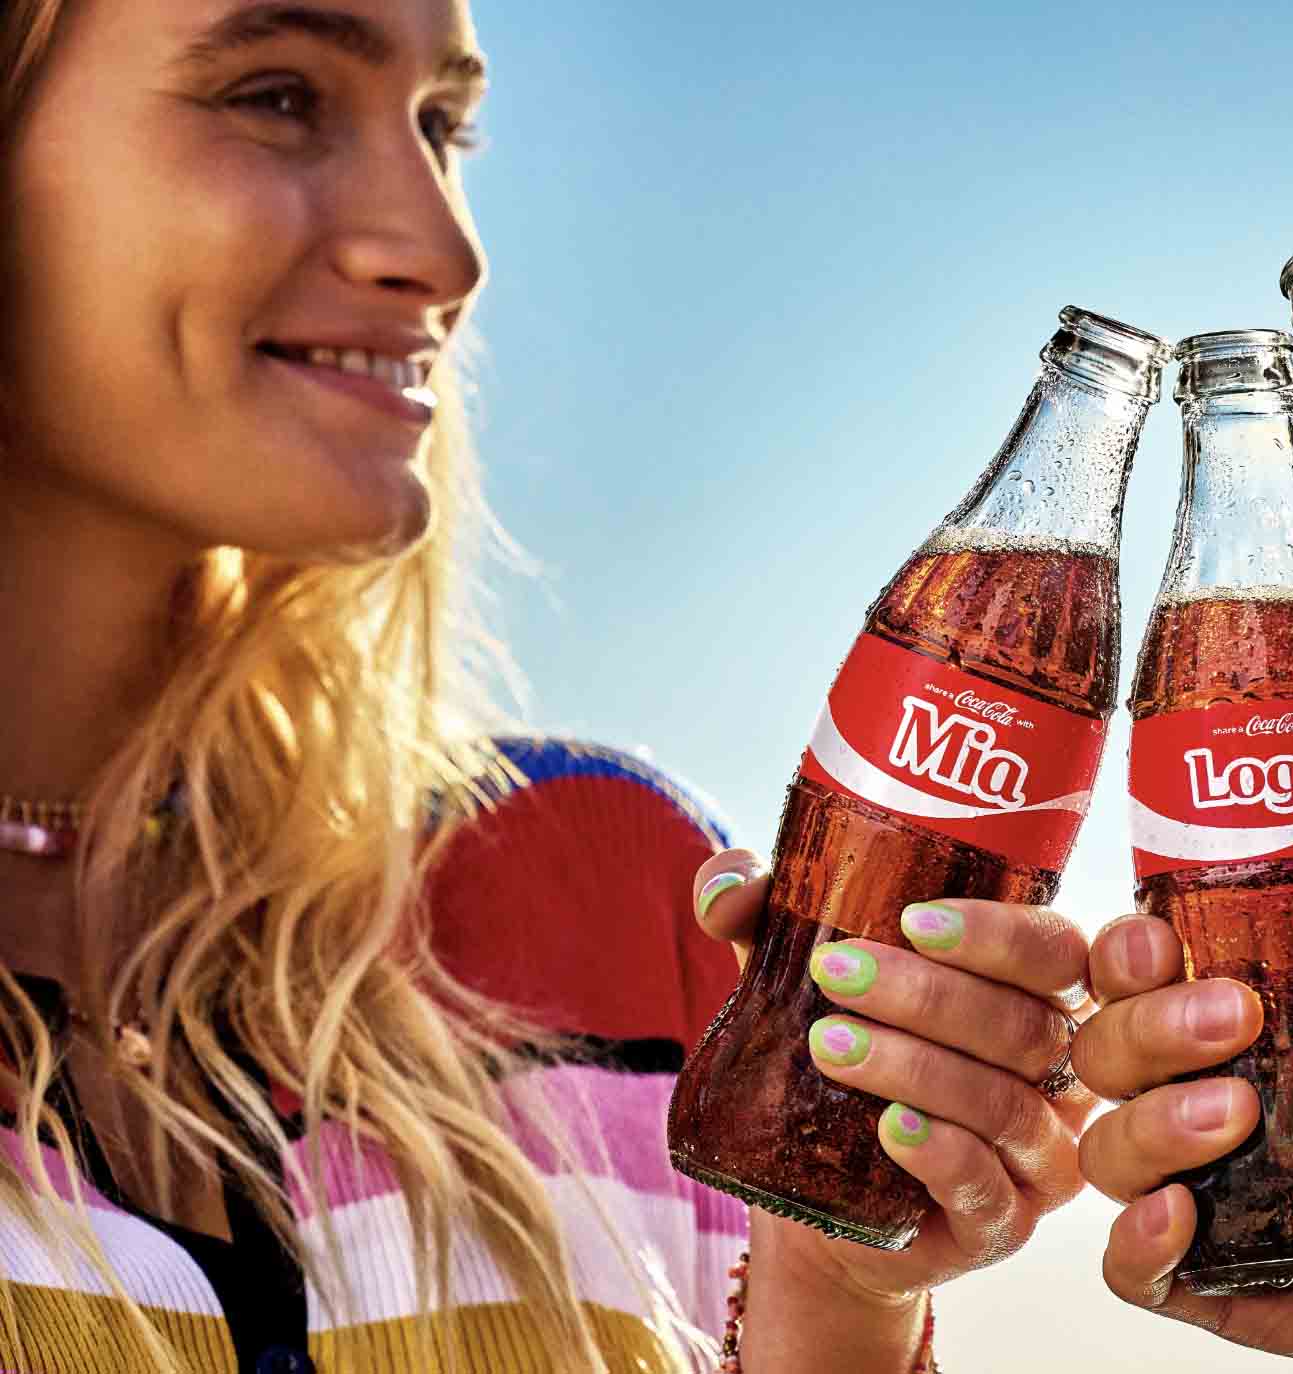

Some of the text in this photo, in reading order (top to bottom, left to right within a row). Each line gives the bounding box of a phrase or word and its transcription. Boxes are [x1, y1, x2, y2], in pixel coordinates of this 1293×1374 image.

[924, 683, 948, 697] share
[954, 689, 1019, 726] Coca-Cola
[1016, 719, 1034, 729] with
[888, 695, 1029, 810] Mia
[1212, 727, 1237, 737] share
